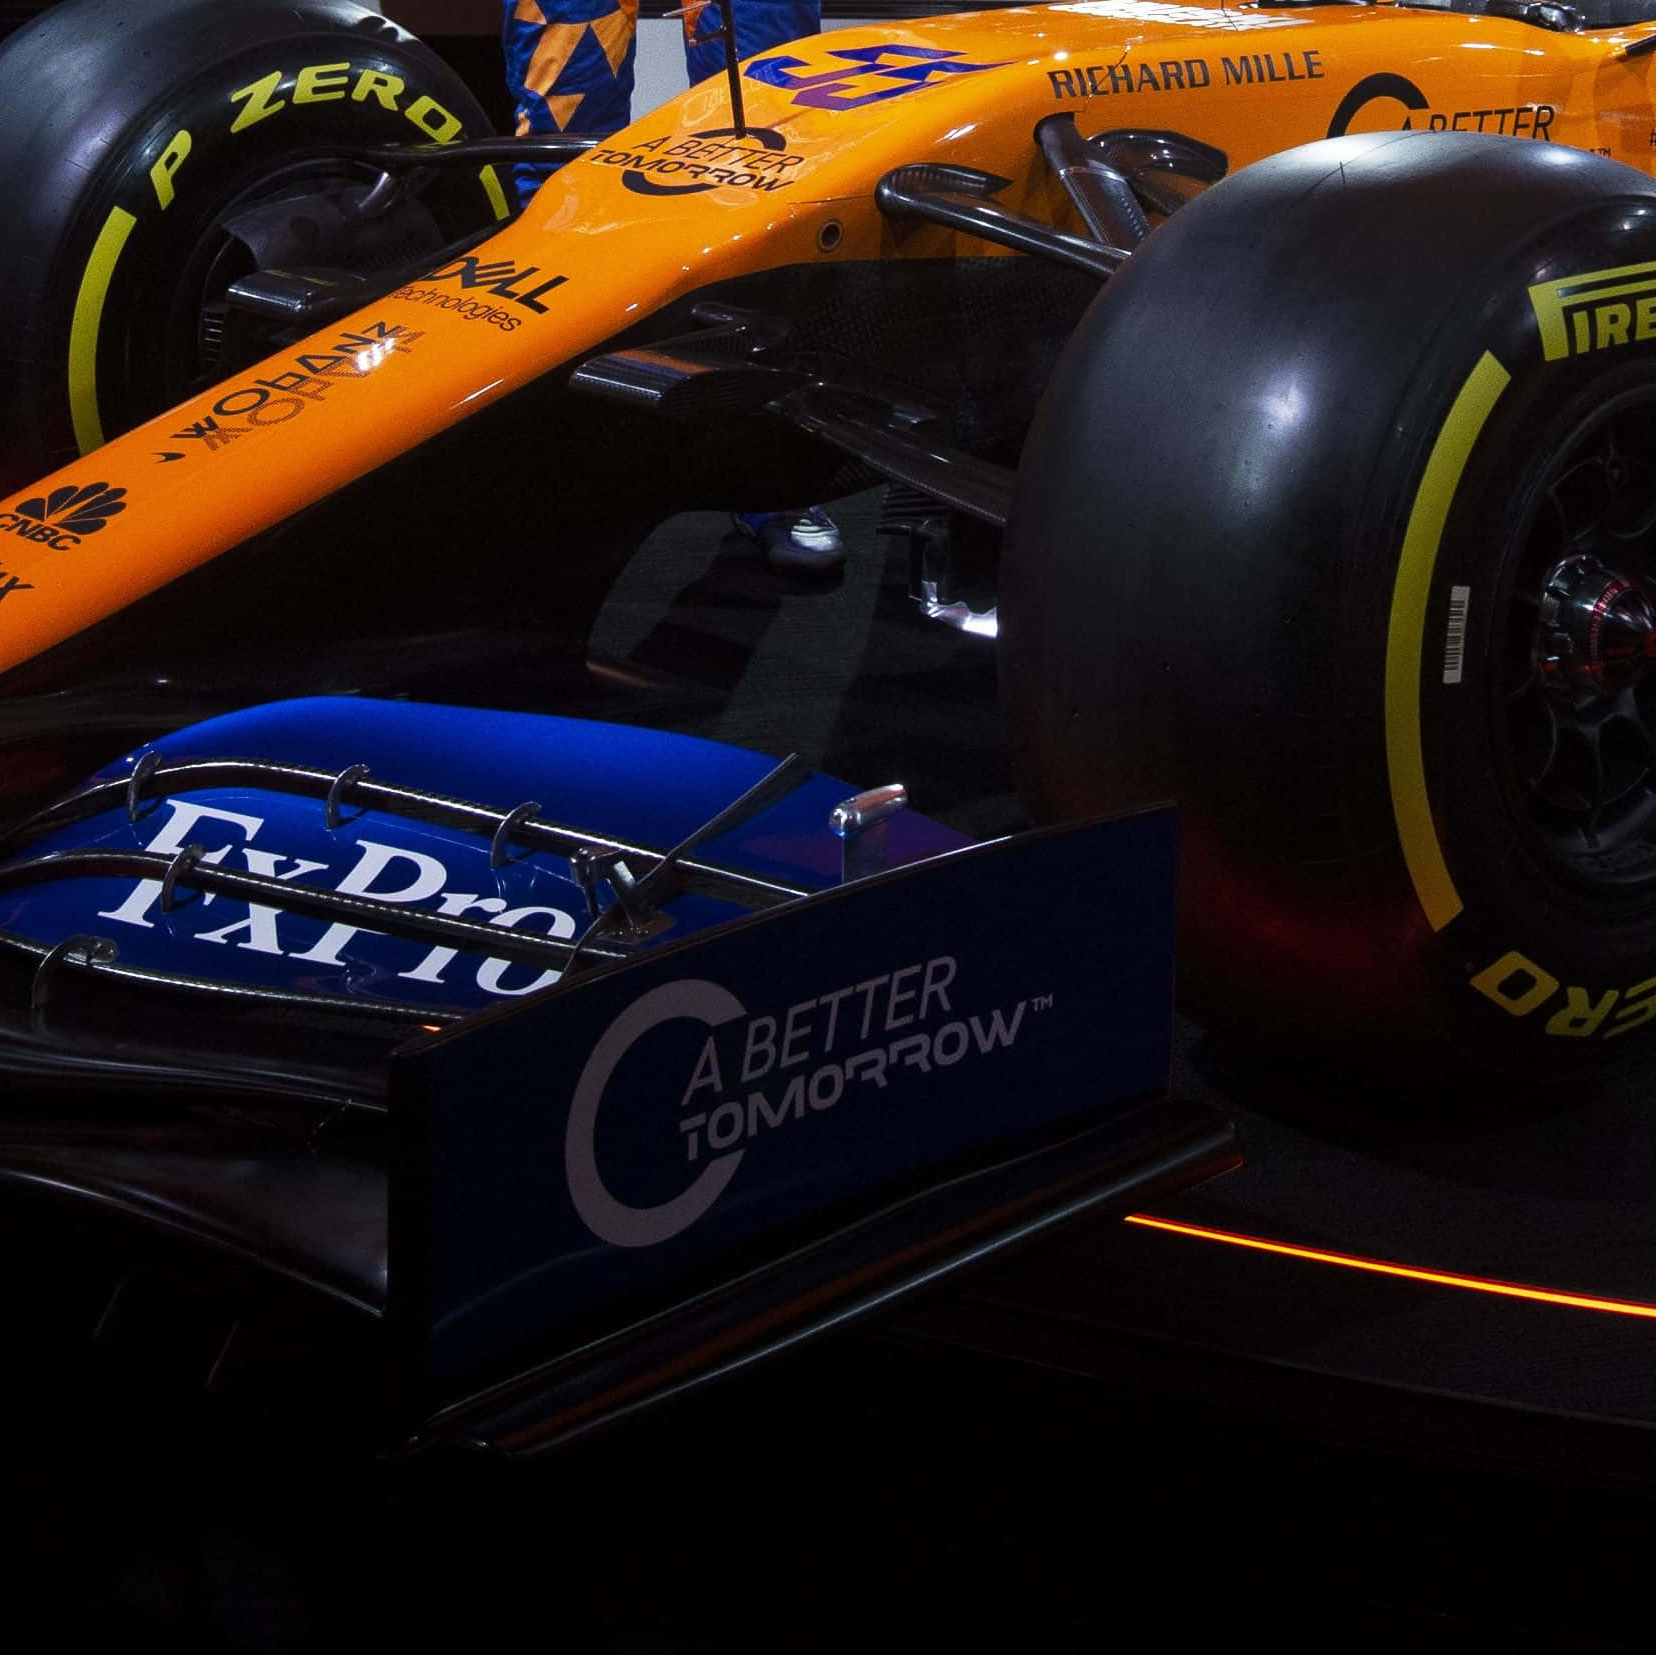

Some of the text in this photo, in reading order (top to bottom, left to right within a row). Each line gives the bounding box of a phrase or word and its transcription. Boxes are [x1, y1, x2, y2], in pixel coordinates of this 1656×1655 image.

[1047, 50, 1326, 99] RICHARD MILLE
[149, 61, 464, 211] P ZERO
[632, 135, 806, 174] A BETTER
[590, 149, 796, 193] TOMORROW
[417, 255, 571, 316] DELL
[680, 955, 958, 1107] A BETTER
